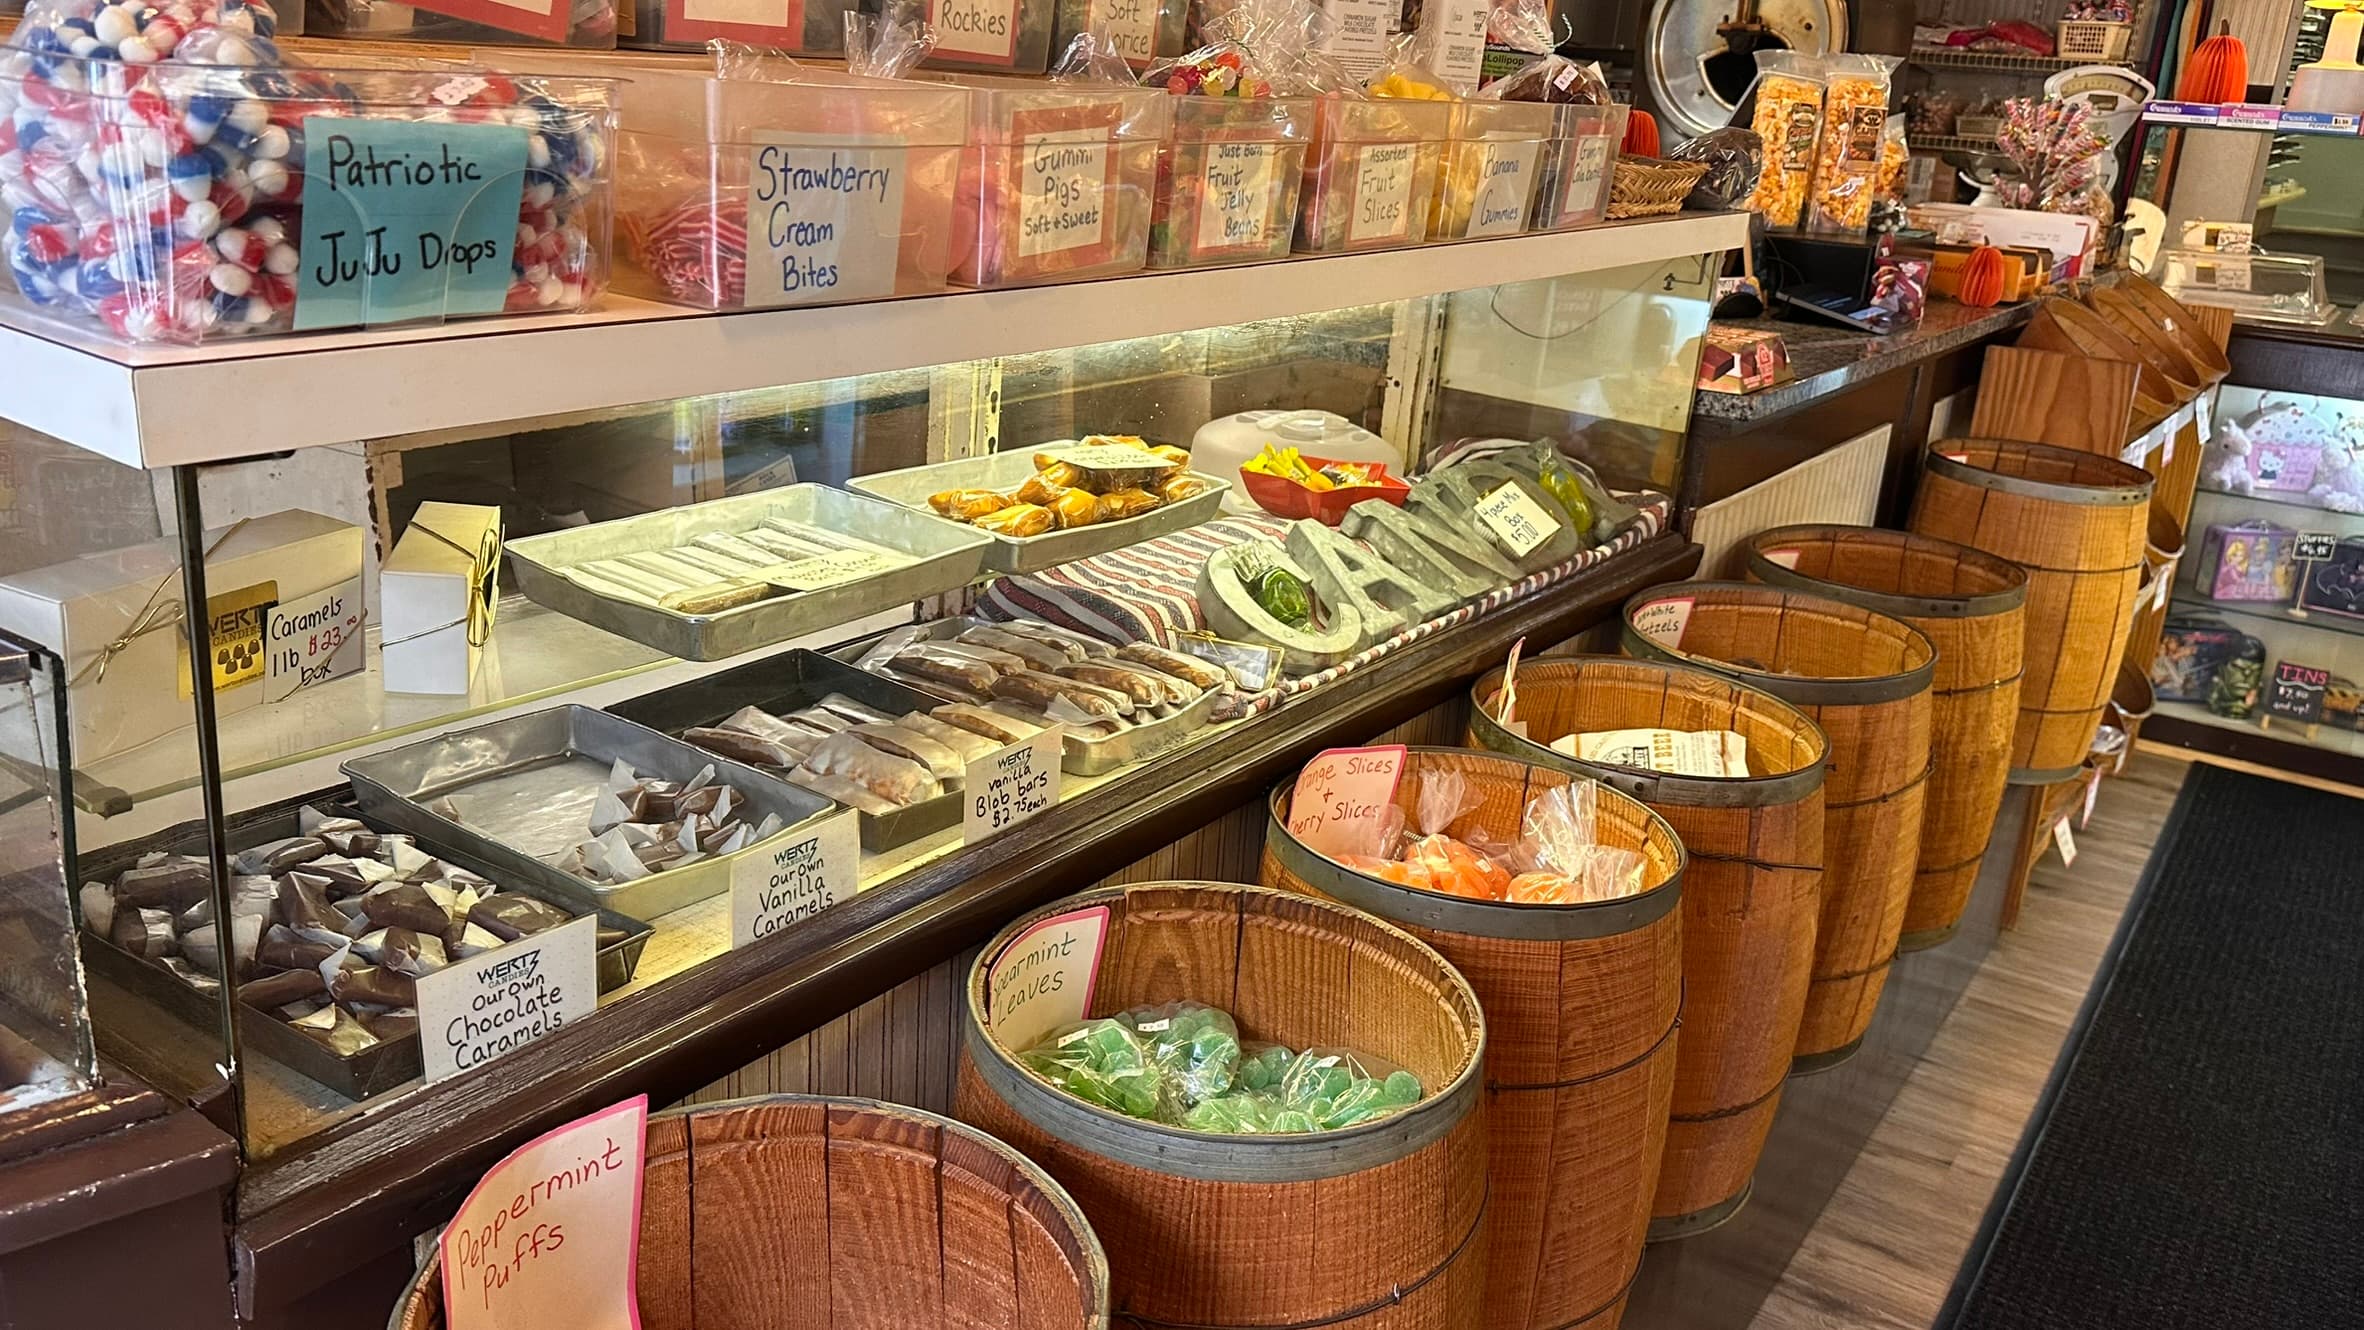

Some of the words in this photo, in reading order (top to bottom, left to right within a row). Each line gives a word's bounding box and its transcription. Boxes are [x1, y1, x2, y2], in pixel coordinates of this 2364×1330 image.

[941, 1, 1006, 35] Rockies
[1105, 0, 1141, 23] Soft
[1110, 29, 1150, 54] orice
[328, 134, 482, 191] Patriotic
[1034, 137, 1094, 173] Gummi
[1483, 143, 1519, 179] Banana
[757, 146, 890, 203] Strawberry
[1044, 176, 1081, 209] Pigs
[1208, 164, 1243, 188] Fruit
[1360, 168, 1396, 195] Fruit
[1220, 188, 1255, 214] Jelly
[1363, 198, 1400, 224] Slices
[1480, 189, 1518, 226] Gummies
[768, 202, 834, 249] Cream
[1024, 213, 1052, 237] Soft
[1062, 205, 1099, 230] Sweet
[1224, 216, 1260, 238] Beans
[419, 231, 497, 278] Drops
[782, 256, 838, 292] Bites
[1504, 512, 1524, 527] Box
[272, 596, 343, 640] Caramels
[300, 658, 333, 686] box
[2280, 665, 2328, 685] TINS
[1346, 757, 1393, 775] Slices
[976, 789, 1010, 818] Blob
[1018, 771, 1048, 797] bars
[773, 837, 819, 866] WERTZ
[759, 875, 825, 913] Vanilla
[752, 891, 834, 939] Caramels
[477, 949, 541, 985] WERTZ
[488, 967, 530, 989] CANDIES
[446, 986, 563, 1047] Chocolate
[998, 970, 1064, 1028] Leaves
[455, 1010, 563, 1070] Caramels
[458, 1137, 623, 1290] Peppermint
